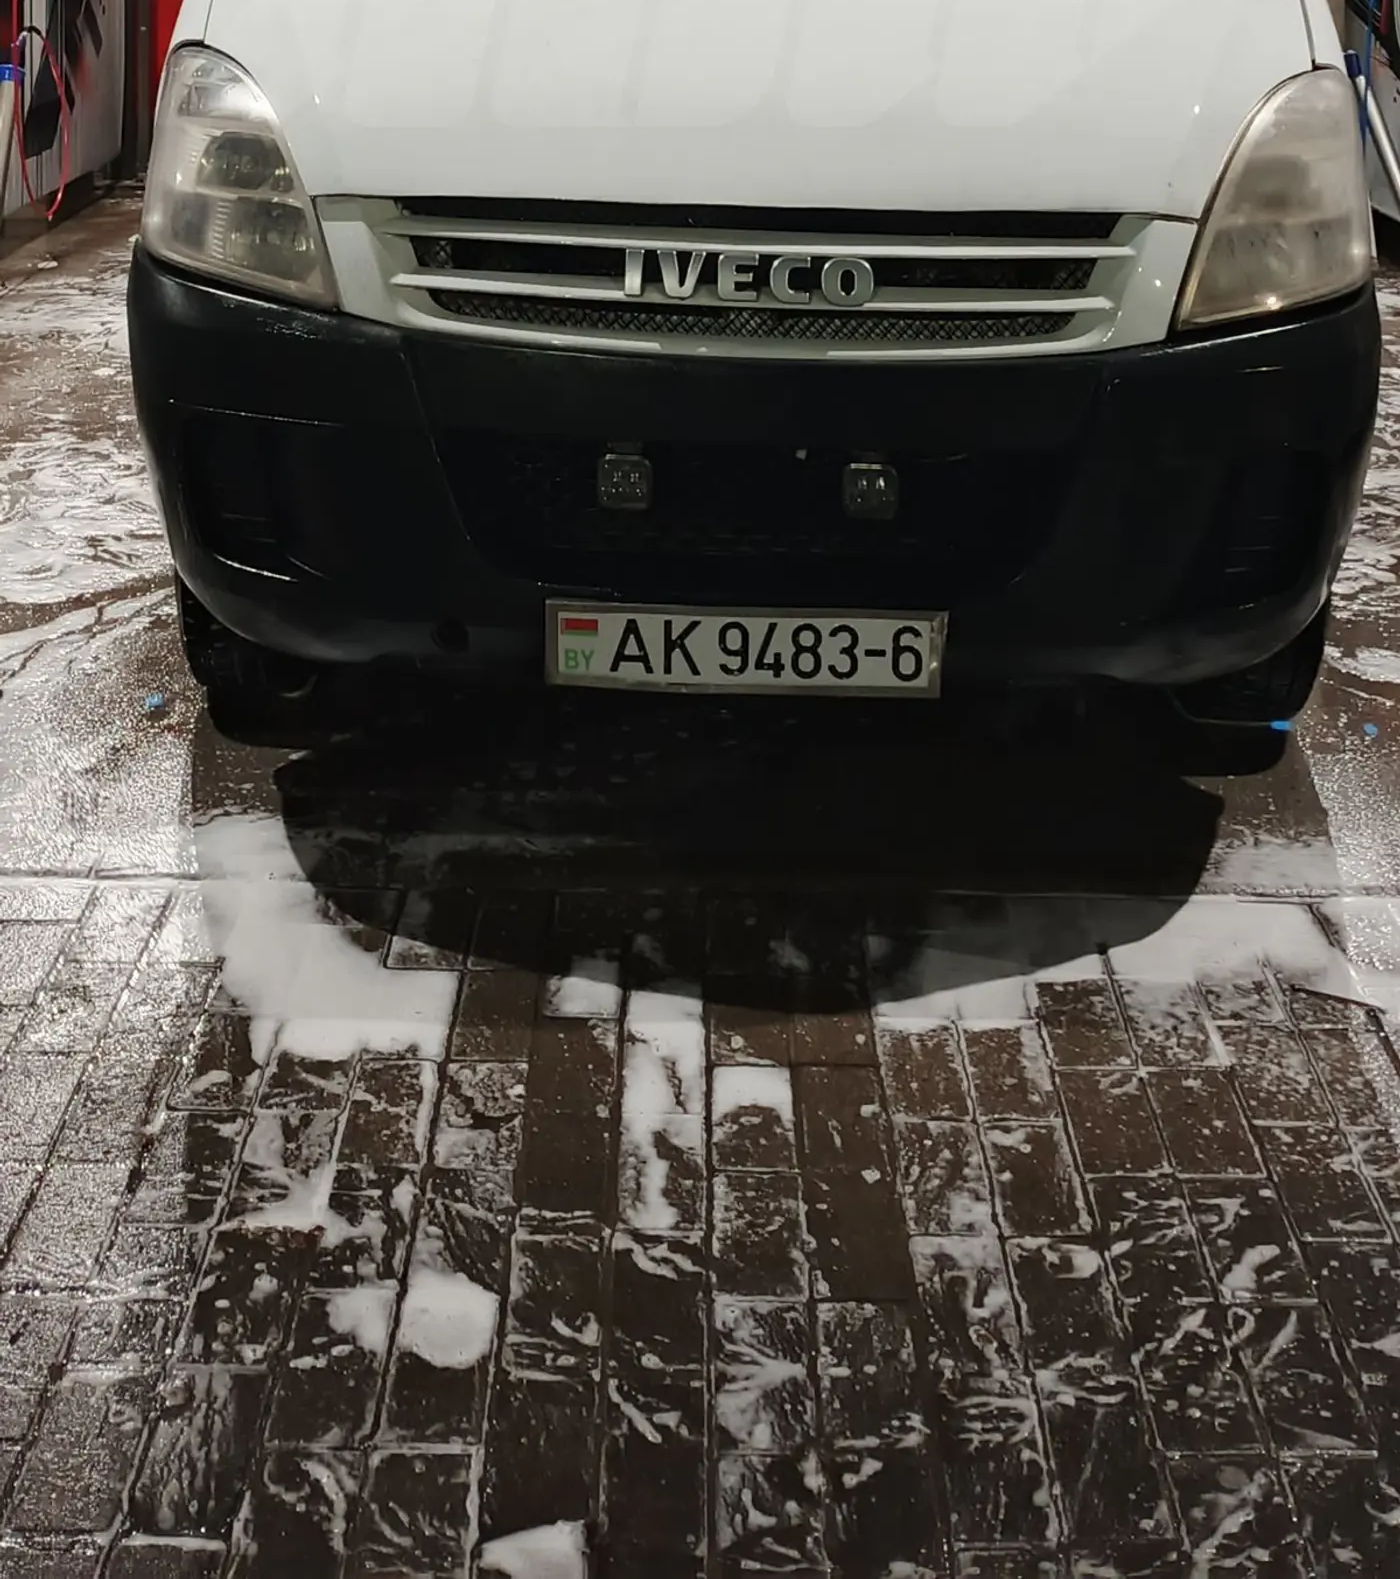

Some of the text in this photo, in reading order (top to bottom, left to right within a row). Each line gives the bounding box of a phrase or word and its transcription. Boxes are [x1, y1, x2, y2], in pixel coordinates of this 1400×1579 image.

[623, 248, 875, 308] IVECO
[564, 648, 595, 671] BY
[609, 618, 925, 683] AK 9483-6
